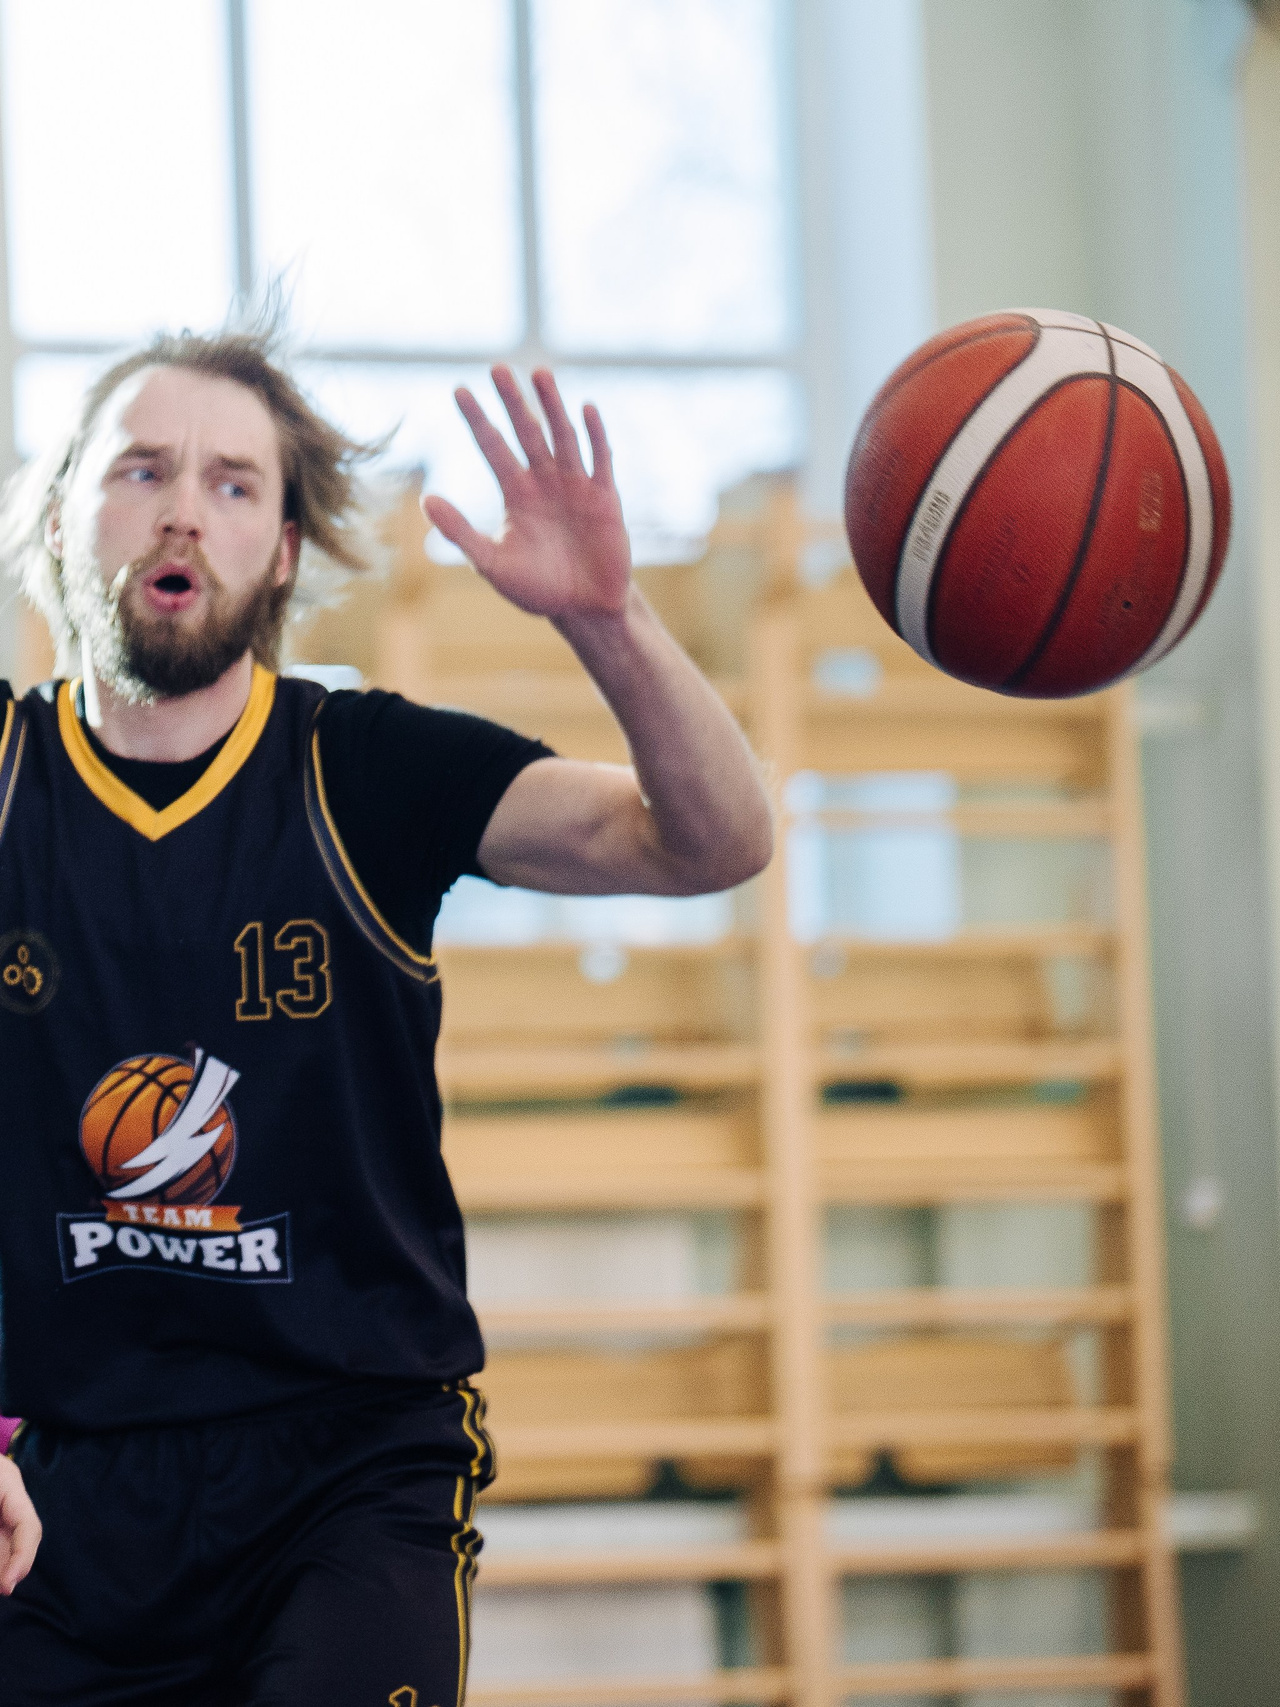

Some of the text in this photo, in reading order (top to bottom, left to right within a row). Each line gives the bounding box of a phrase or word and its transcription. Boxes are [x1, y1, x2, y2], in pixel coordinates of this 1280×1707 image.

[234, 919, 332, 1021] 13
[123, 1204, 213, 1228] TEAM
[70, 1222, 282, 1273] POWER
